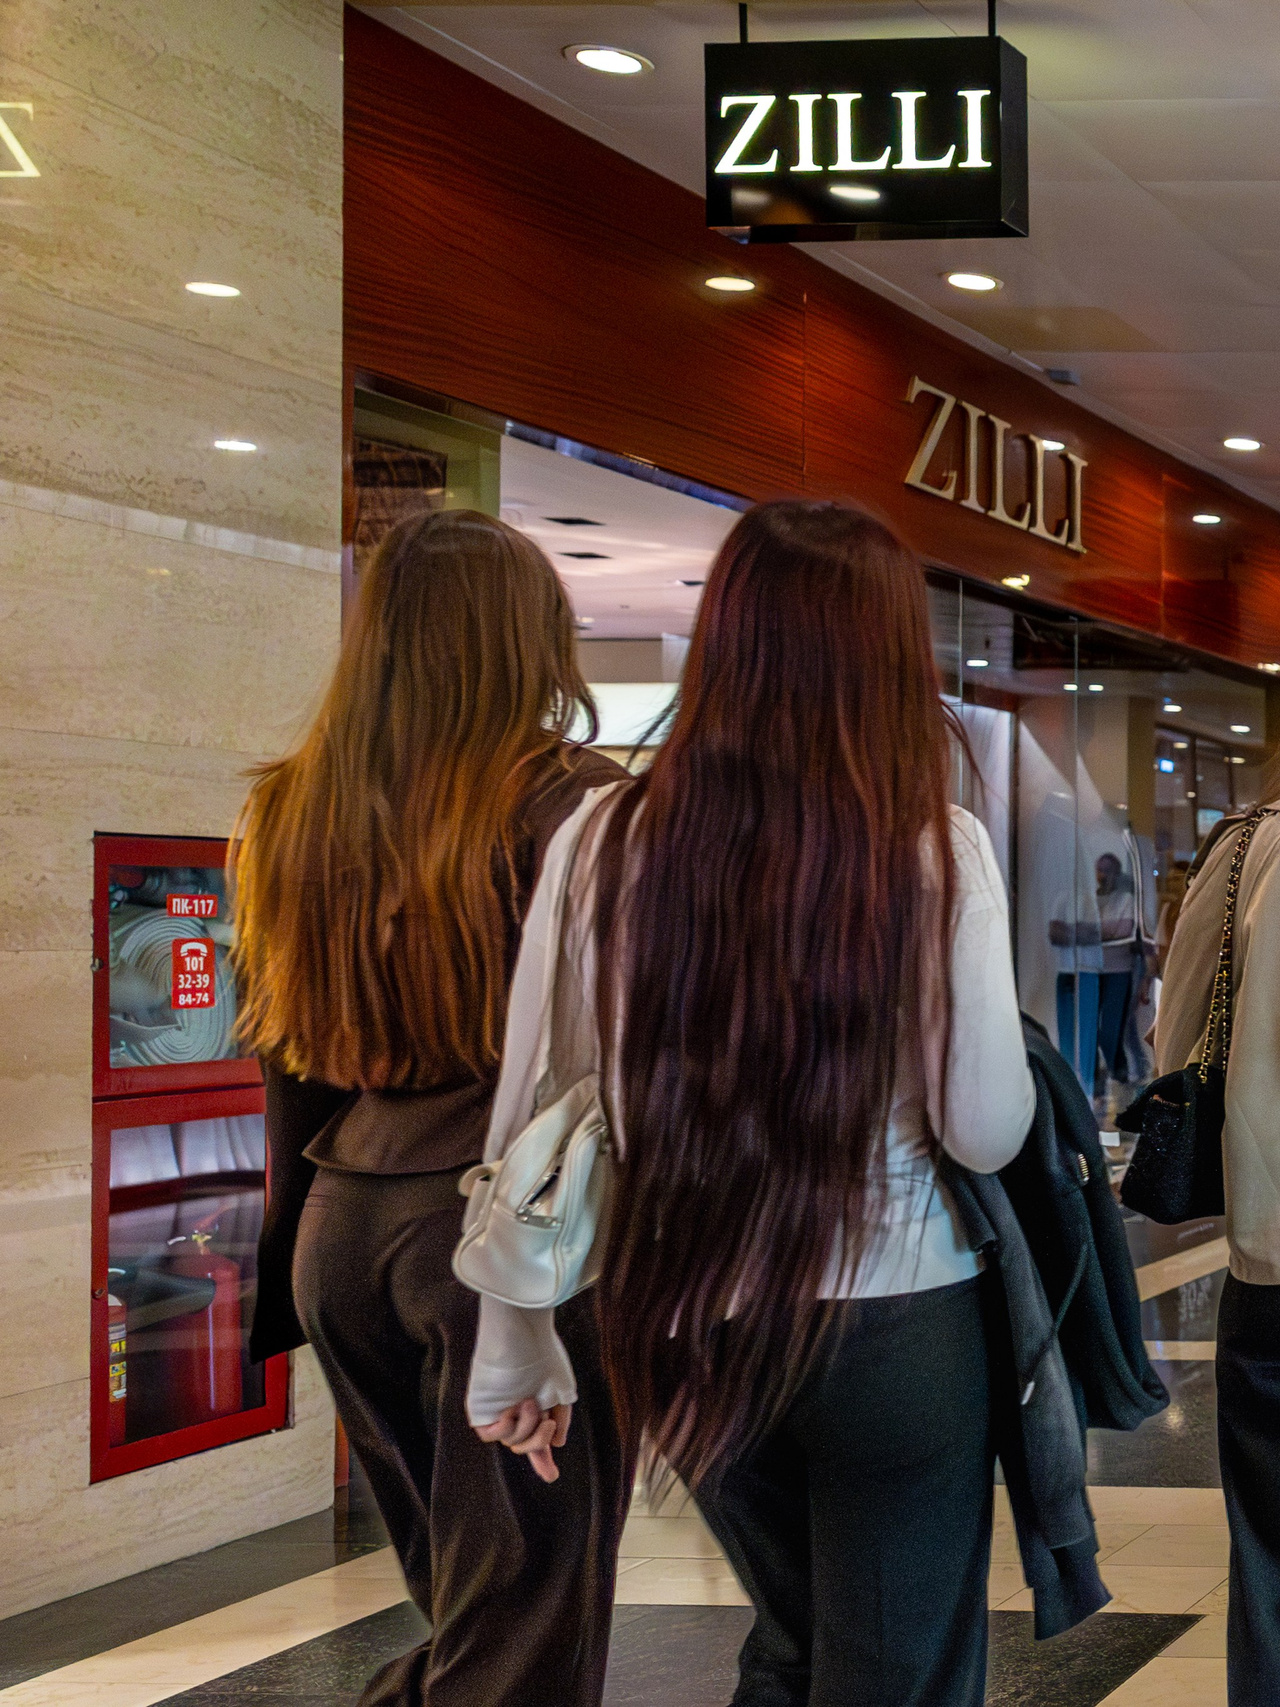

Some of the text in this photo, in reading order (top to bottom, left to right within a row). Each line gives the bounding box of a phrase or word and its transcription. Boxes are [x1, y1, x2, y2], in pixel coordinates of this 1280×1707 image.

[714, 89, 993, 174] ZILLI
[902, 375, 1089, 555] ZILLI
[172, 897, 215, 915] ПК-117
[184, 956, 205, 971] 101
[178, 974, 210, 989] 32-39
[178, 993, 209, 1005] 84-74
